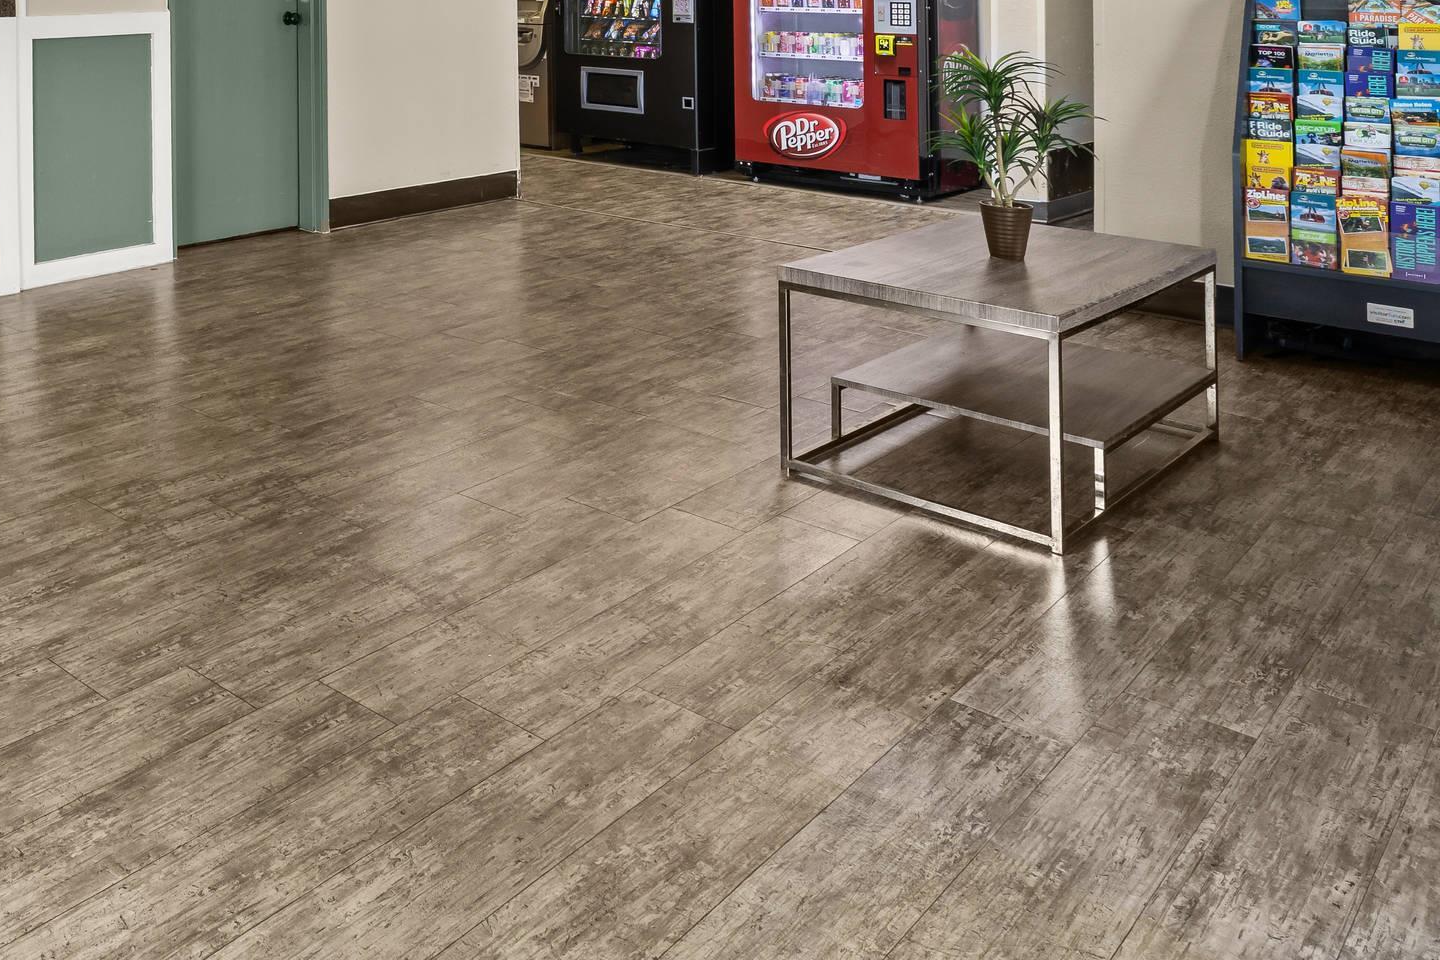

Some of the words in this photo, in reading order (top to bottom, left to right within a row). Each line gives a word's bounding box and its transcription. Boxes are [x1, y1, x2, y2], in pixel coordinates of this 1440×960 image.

[1360, 14, 1398, 23] PARADISE
[1349, 29, 1376, 37] Ride
[1349, 36, 1384, 45] Guide
[795, 118, 818, 136] Dr
[1256, 121, 1282, 130] Ride
[779, 121, 834, 152] Pepper
[1257, 129, 1290, 138] Guide
[1246, 189, 1286, 200] ZipLines
[1336, 198, 1378, 208] ZipLine
[1416, 207, 1436, 230] HERE!
[1395, 236, 1416, 270] HISTORY
